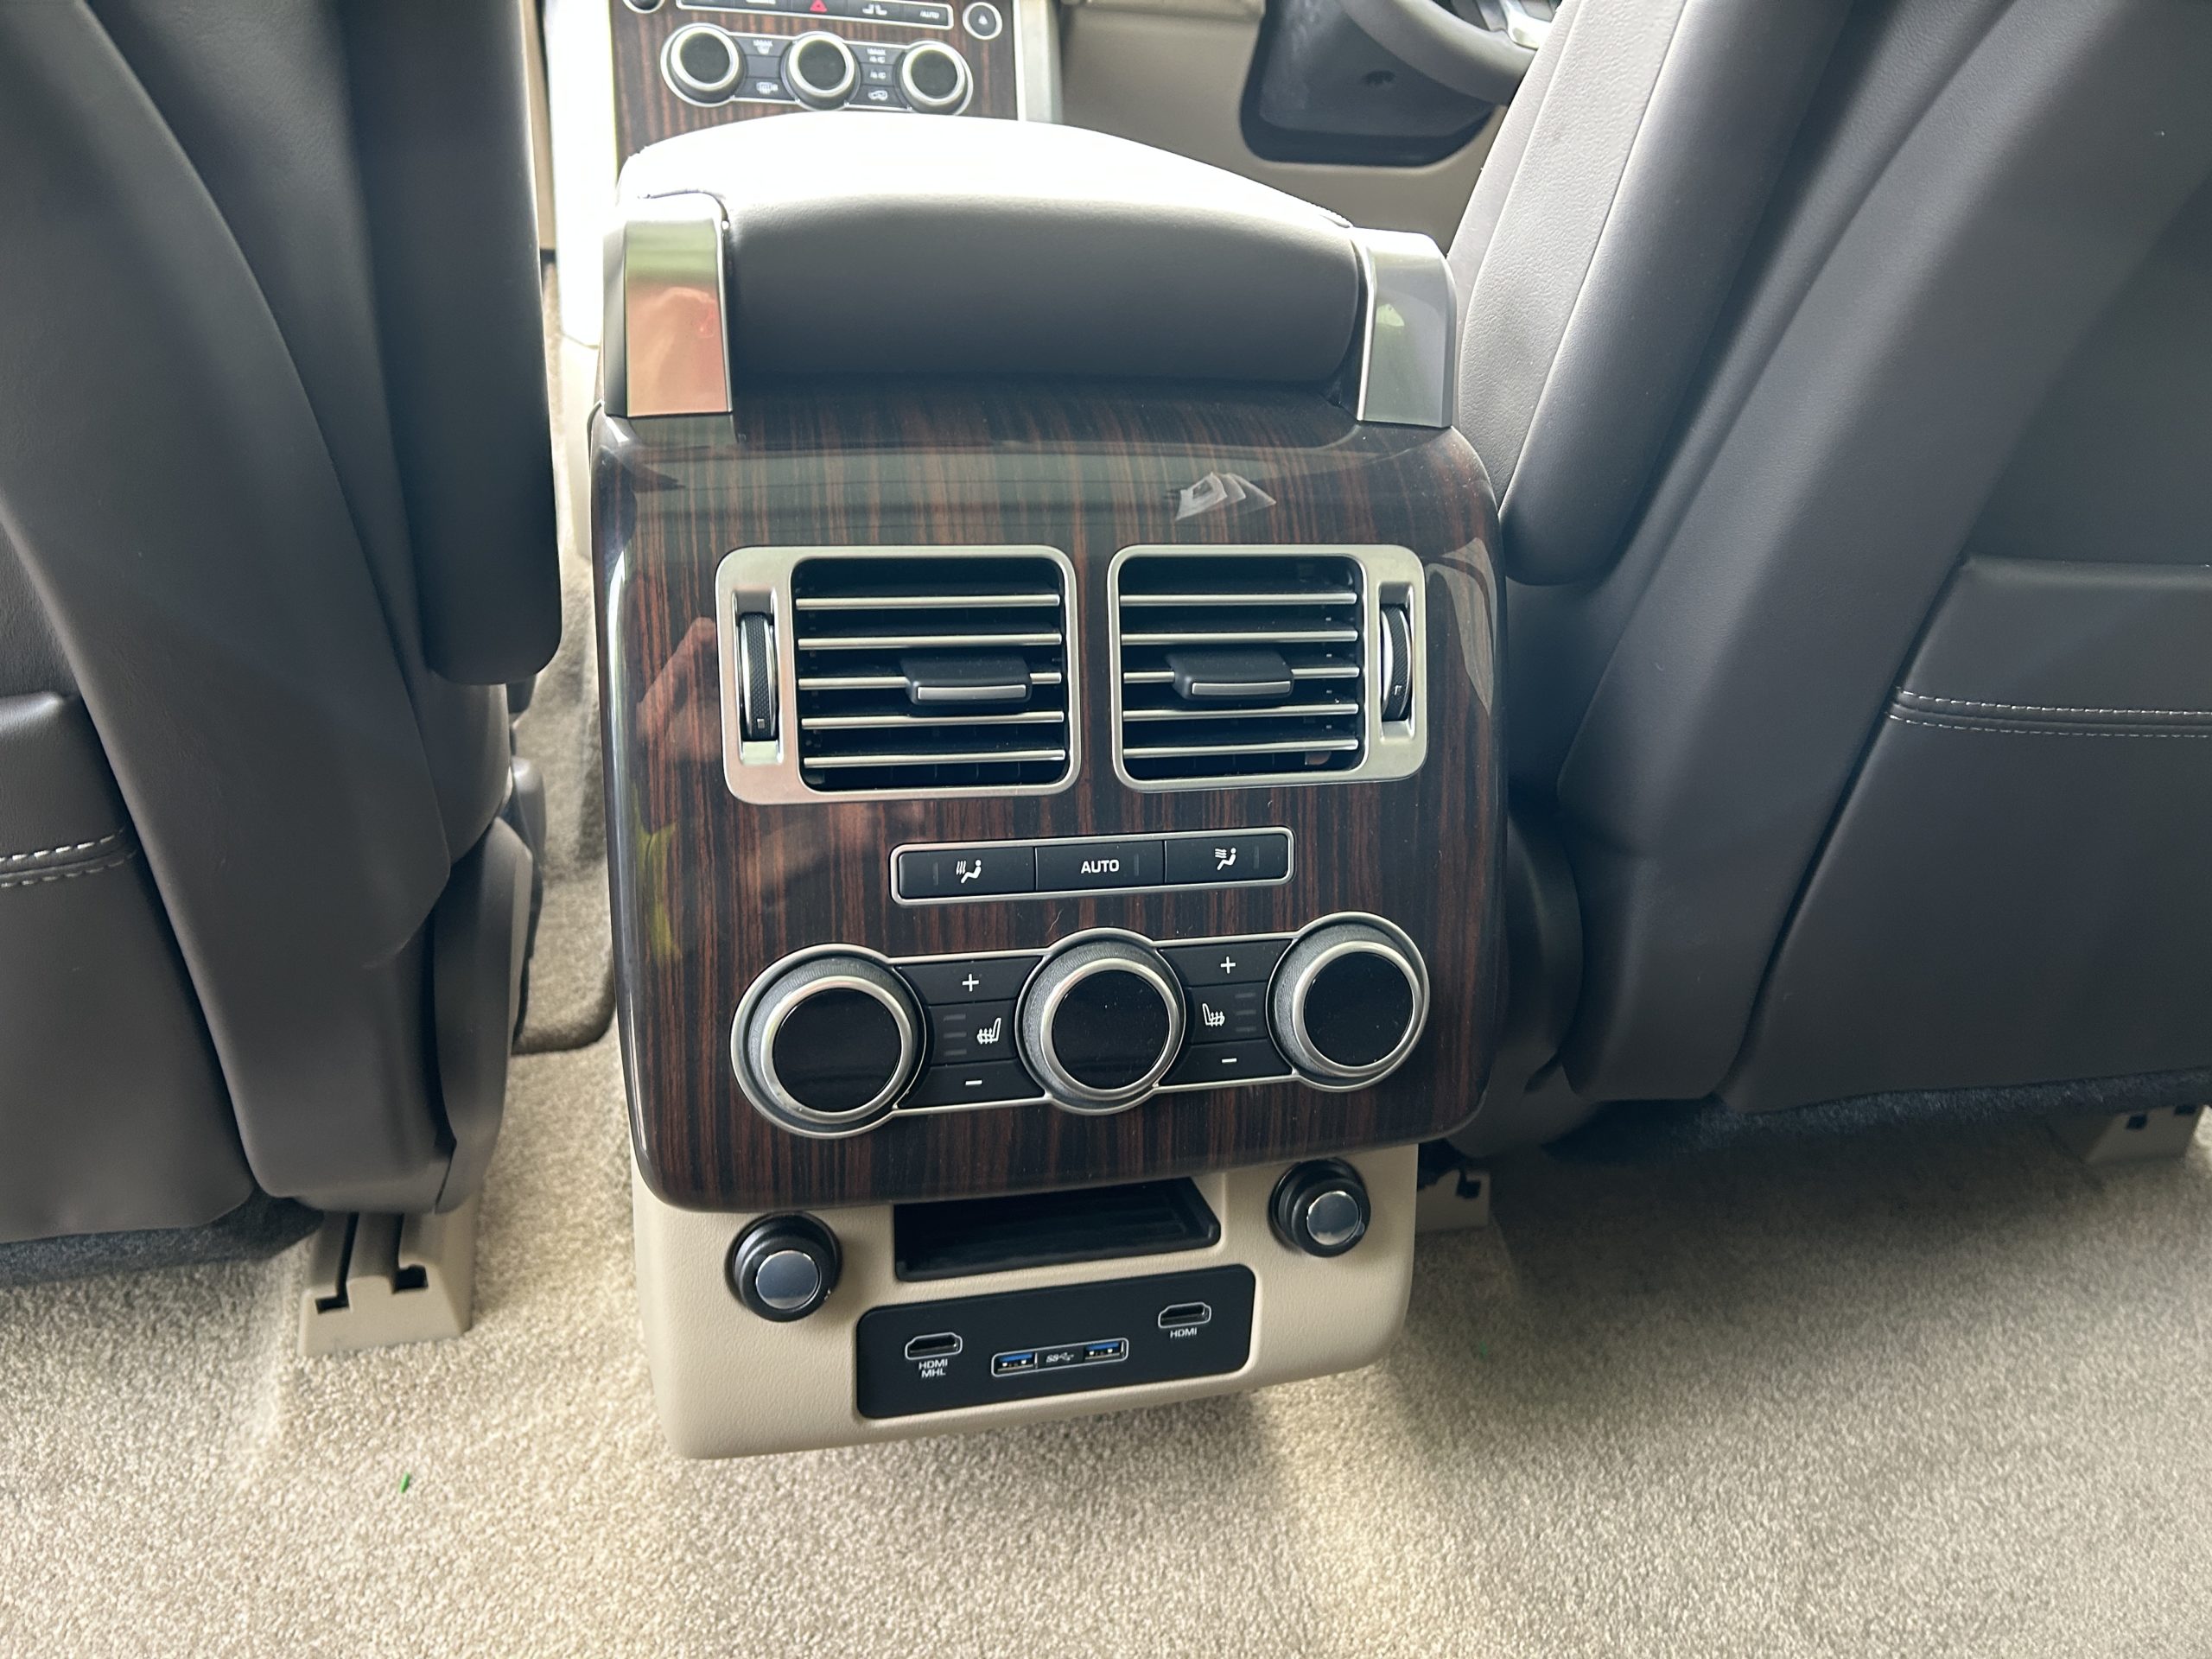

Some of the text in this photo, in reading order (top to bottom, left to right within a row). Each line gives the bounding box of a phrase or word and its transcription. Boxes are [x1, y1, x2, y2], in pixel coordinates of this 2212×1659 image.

[1080, 859, 1120, 874] AUTO
[1169, 1327, 1198, 1338] HDMI
[918, 1358, 948, 1370] HDMI
[921, 1368, 946, 1378] MHL
